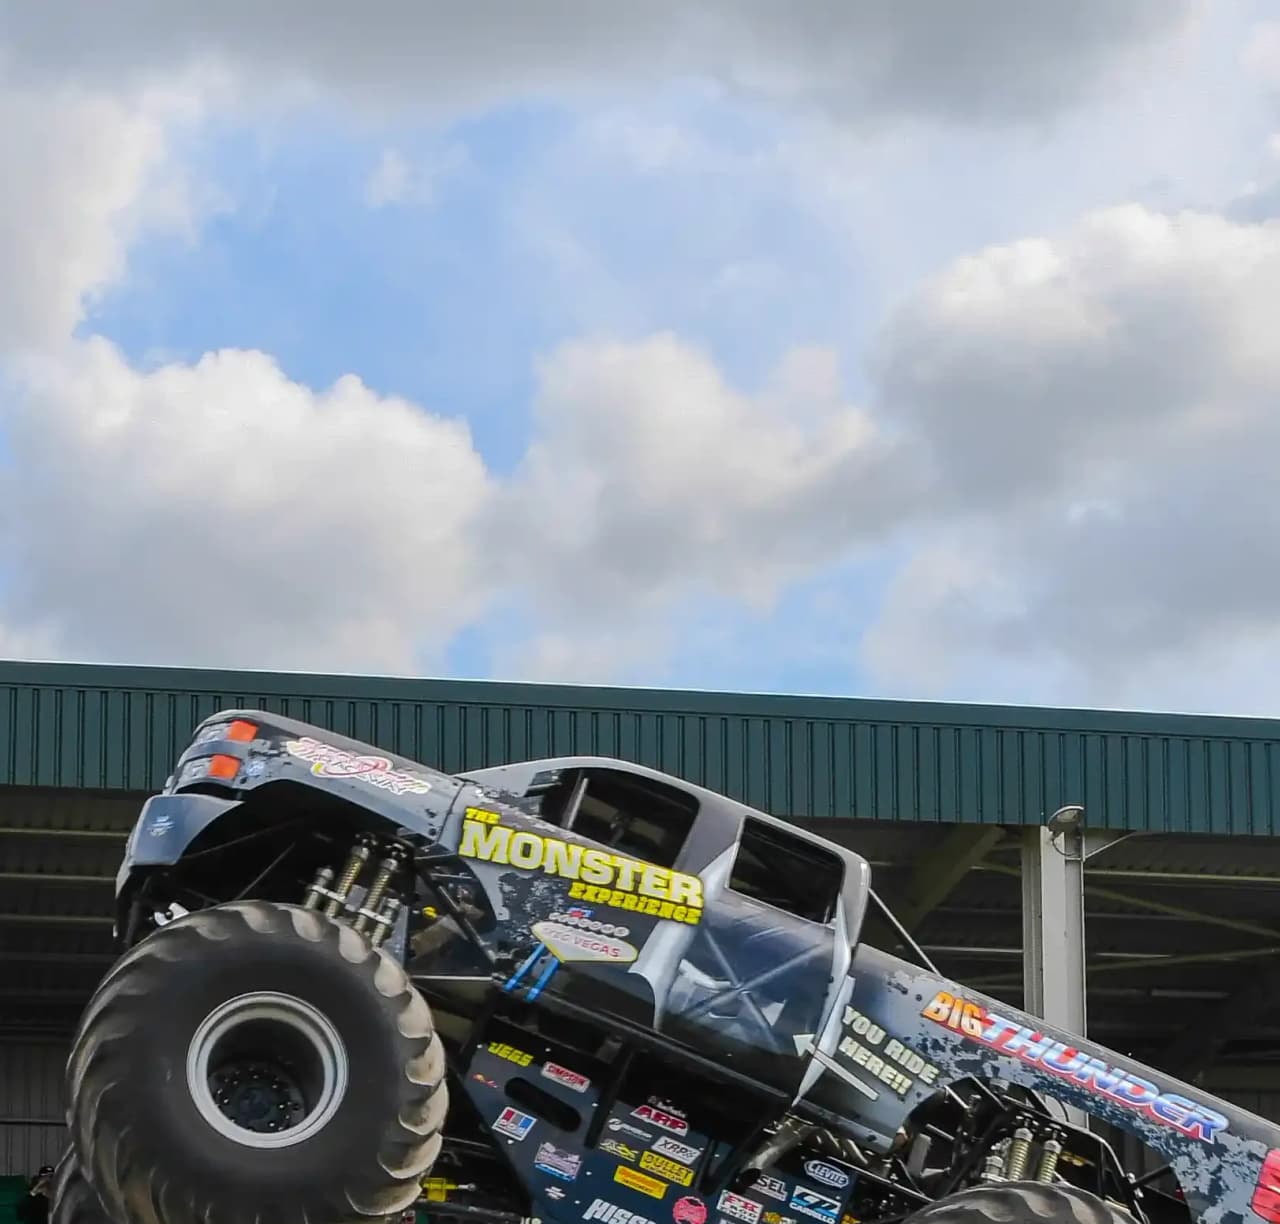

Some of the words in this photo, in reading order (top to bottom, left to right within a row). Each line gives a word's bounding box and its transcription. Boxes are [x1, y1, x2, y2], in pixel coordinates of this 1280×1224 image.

[465, 807, 501, 825] THE
[459, 820, 704, 907] MONSTER
[573, 936, 621, 958] VEGAS
[487, 1041, 534, 1067] JEGS
[842, 1005, 886, 1045] YOU
[883, 1038, 940, 1084] RIDE
[838, 1035, 913, 1095] HERE!!
[922, 990, 984, 1038] BIG
[980, 1012, 1231, 1144] THUNDER
[633, 1105, 688, 1132] ARP
[658, 1139, 687, 1155] XRP
[643, 1154, 693, 1180] BULLET
[807, 1160, 847, 1185] CLEVITE
